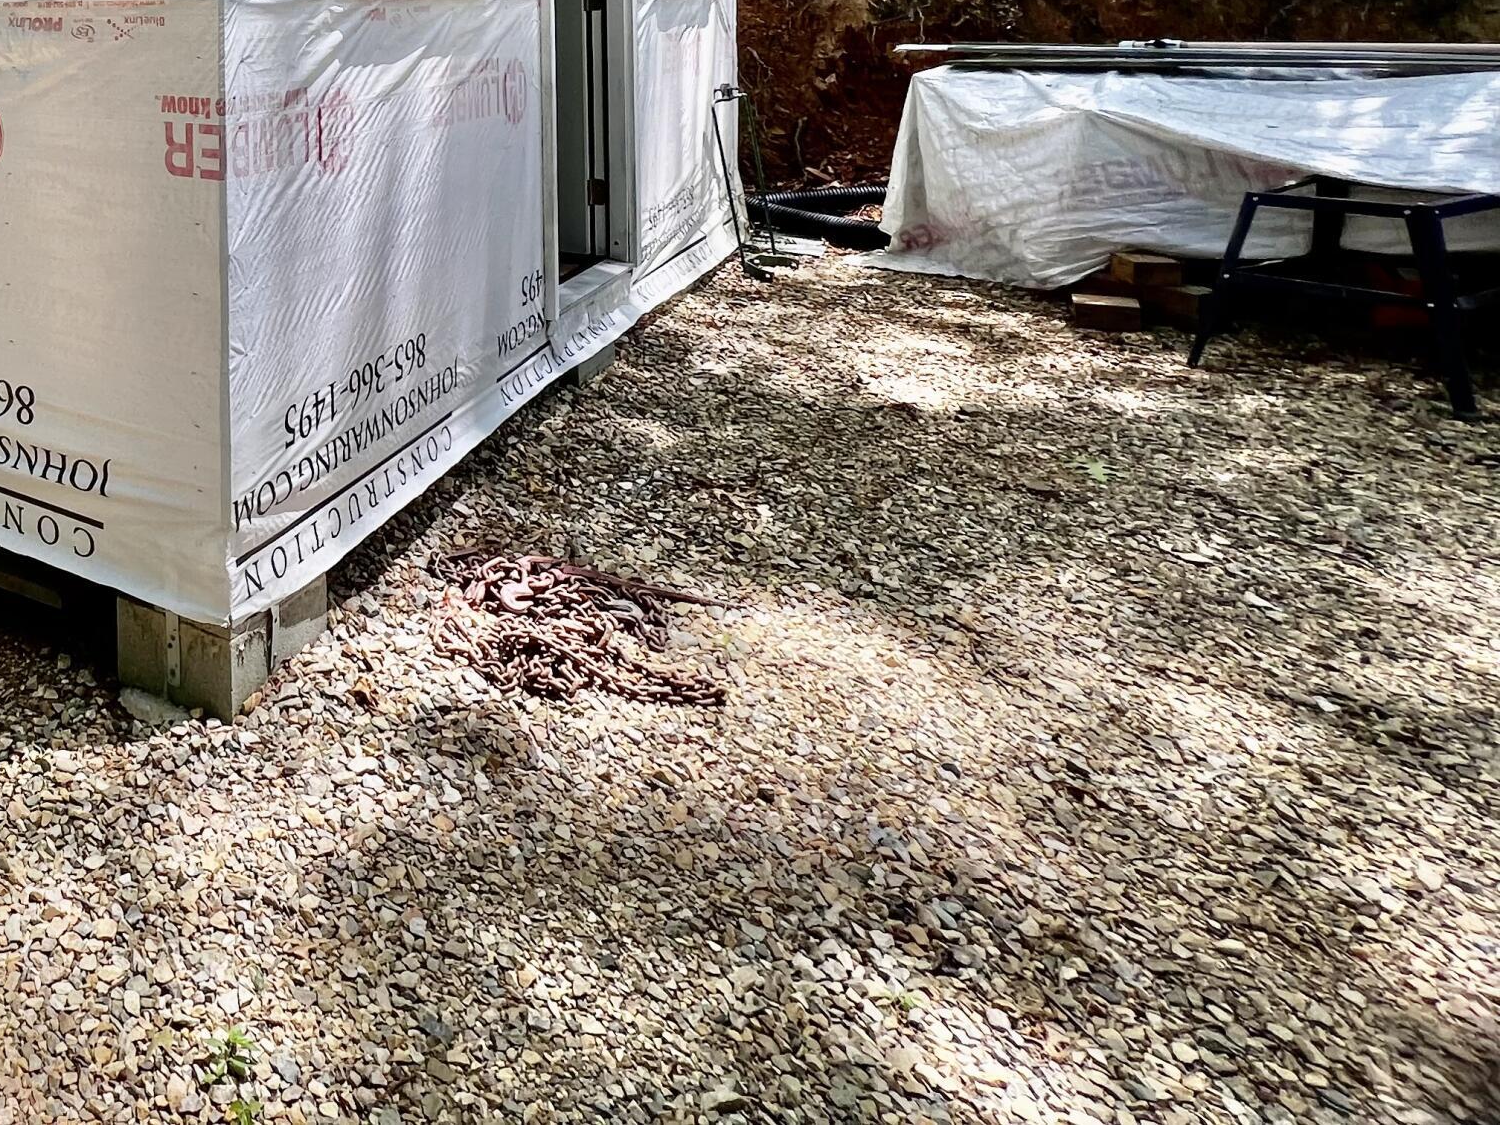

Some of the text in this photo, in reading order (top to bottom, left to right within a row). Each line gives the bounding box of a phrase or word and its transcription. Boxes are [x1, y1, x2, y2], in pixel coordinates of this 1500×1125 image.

[231, 355, 459, 534] JOHNSONWARING.COM
[283, 332, 426, 450] 865-366-1495
[243, 425, 453, 600] CONSTRUCTION
